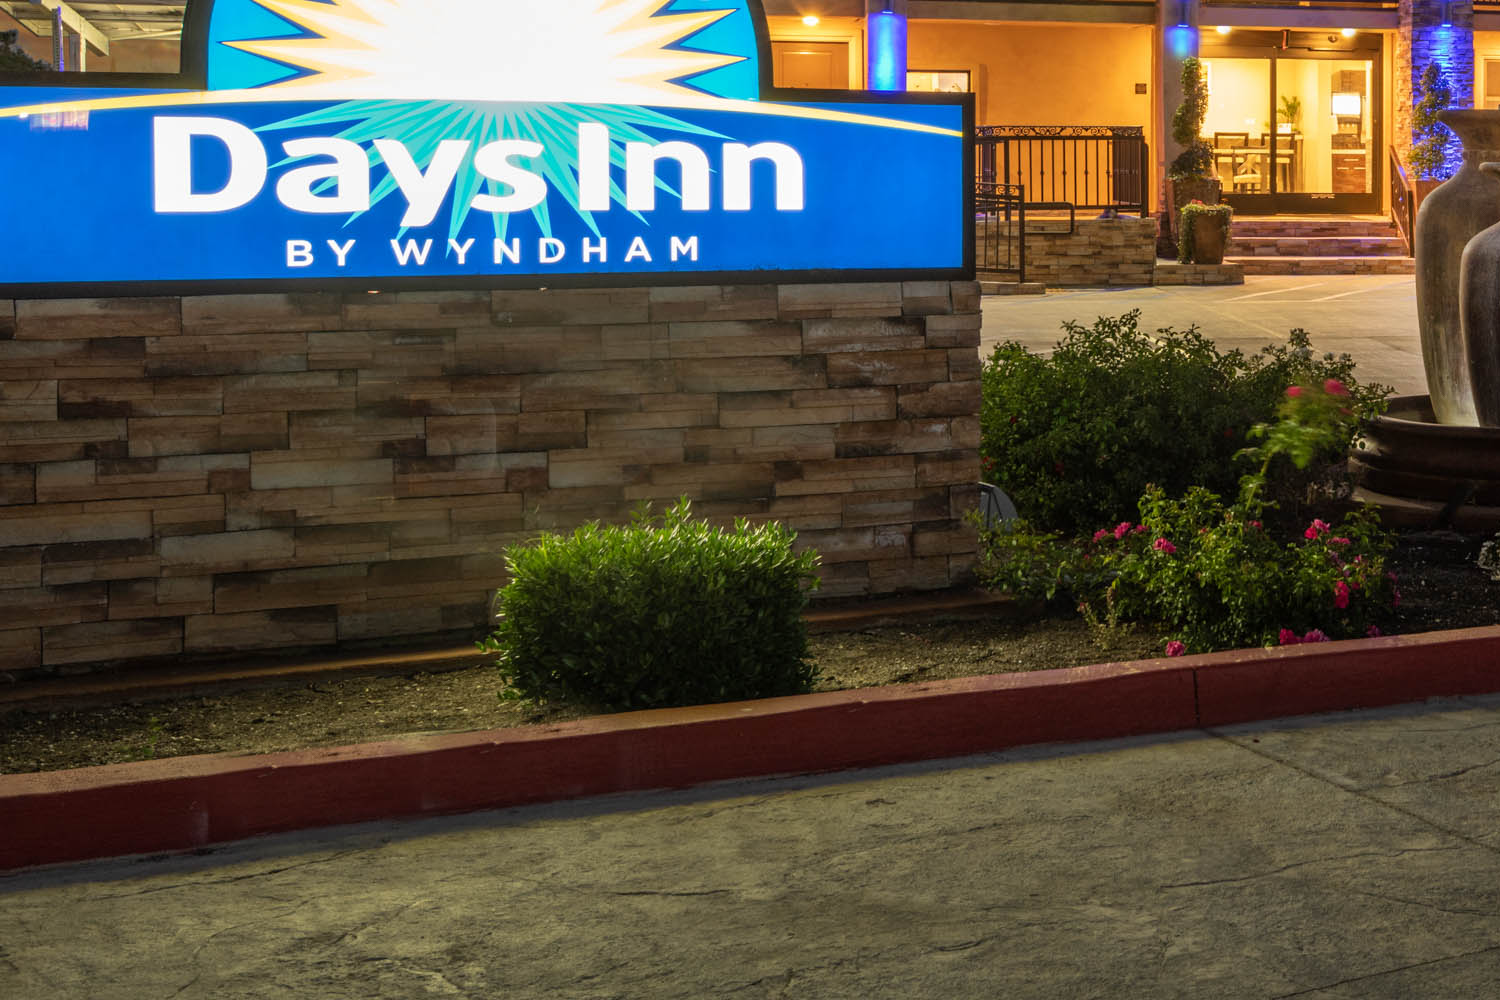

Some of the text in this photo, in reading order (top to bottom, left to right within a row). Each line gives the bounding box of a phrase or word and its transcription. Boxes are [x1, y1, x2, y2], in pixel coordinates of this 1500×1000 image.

[153, 115, 805, 228] Days Inn
[287, 235, 699, 267] BY WYNDHAM
